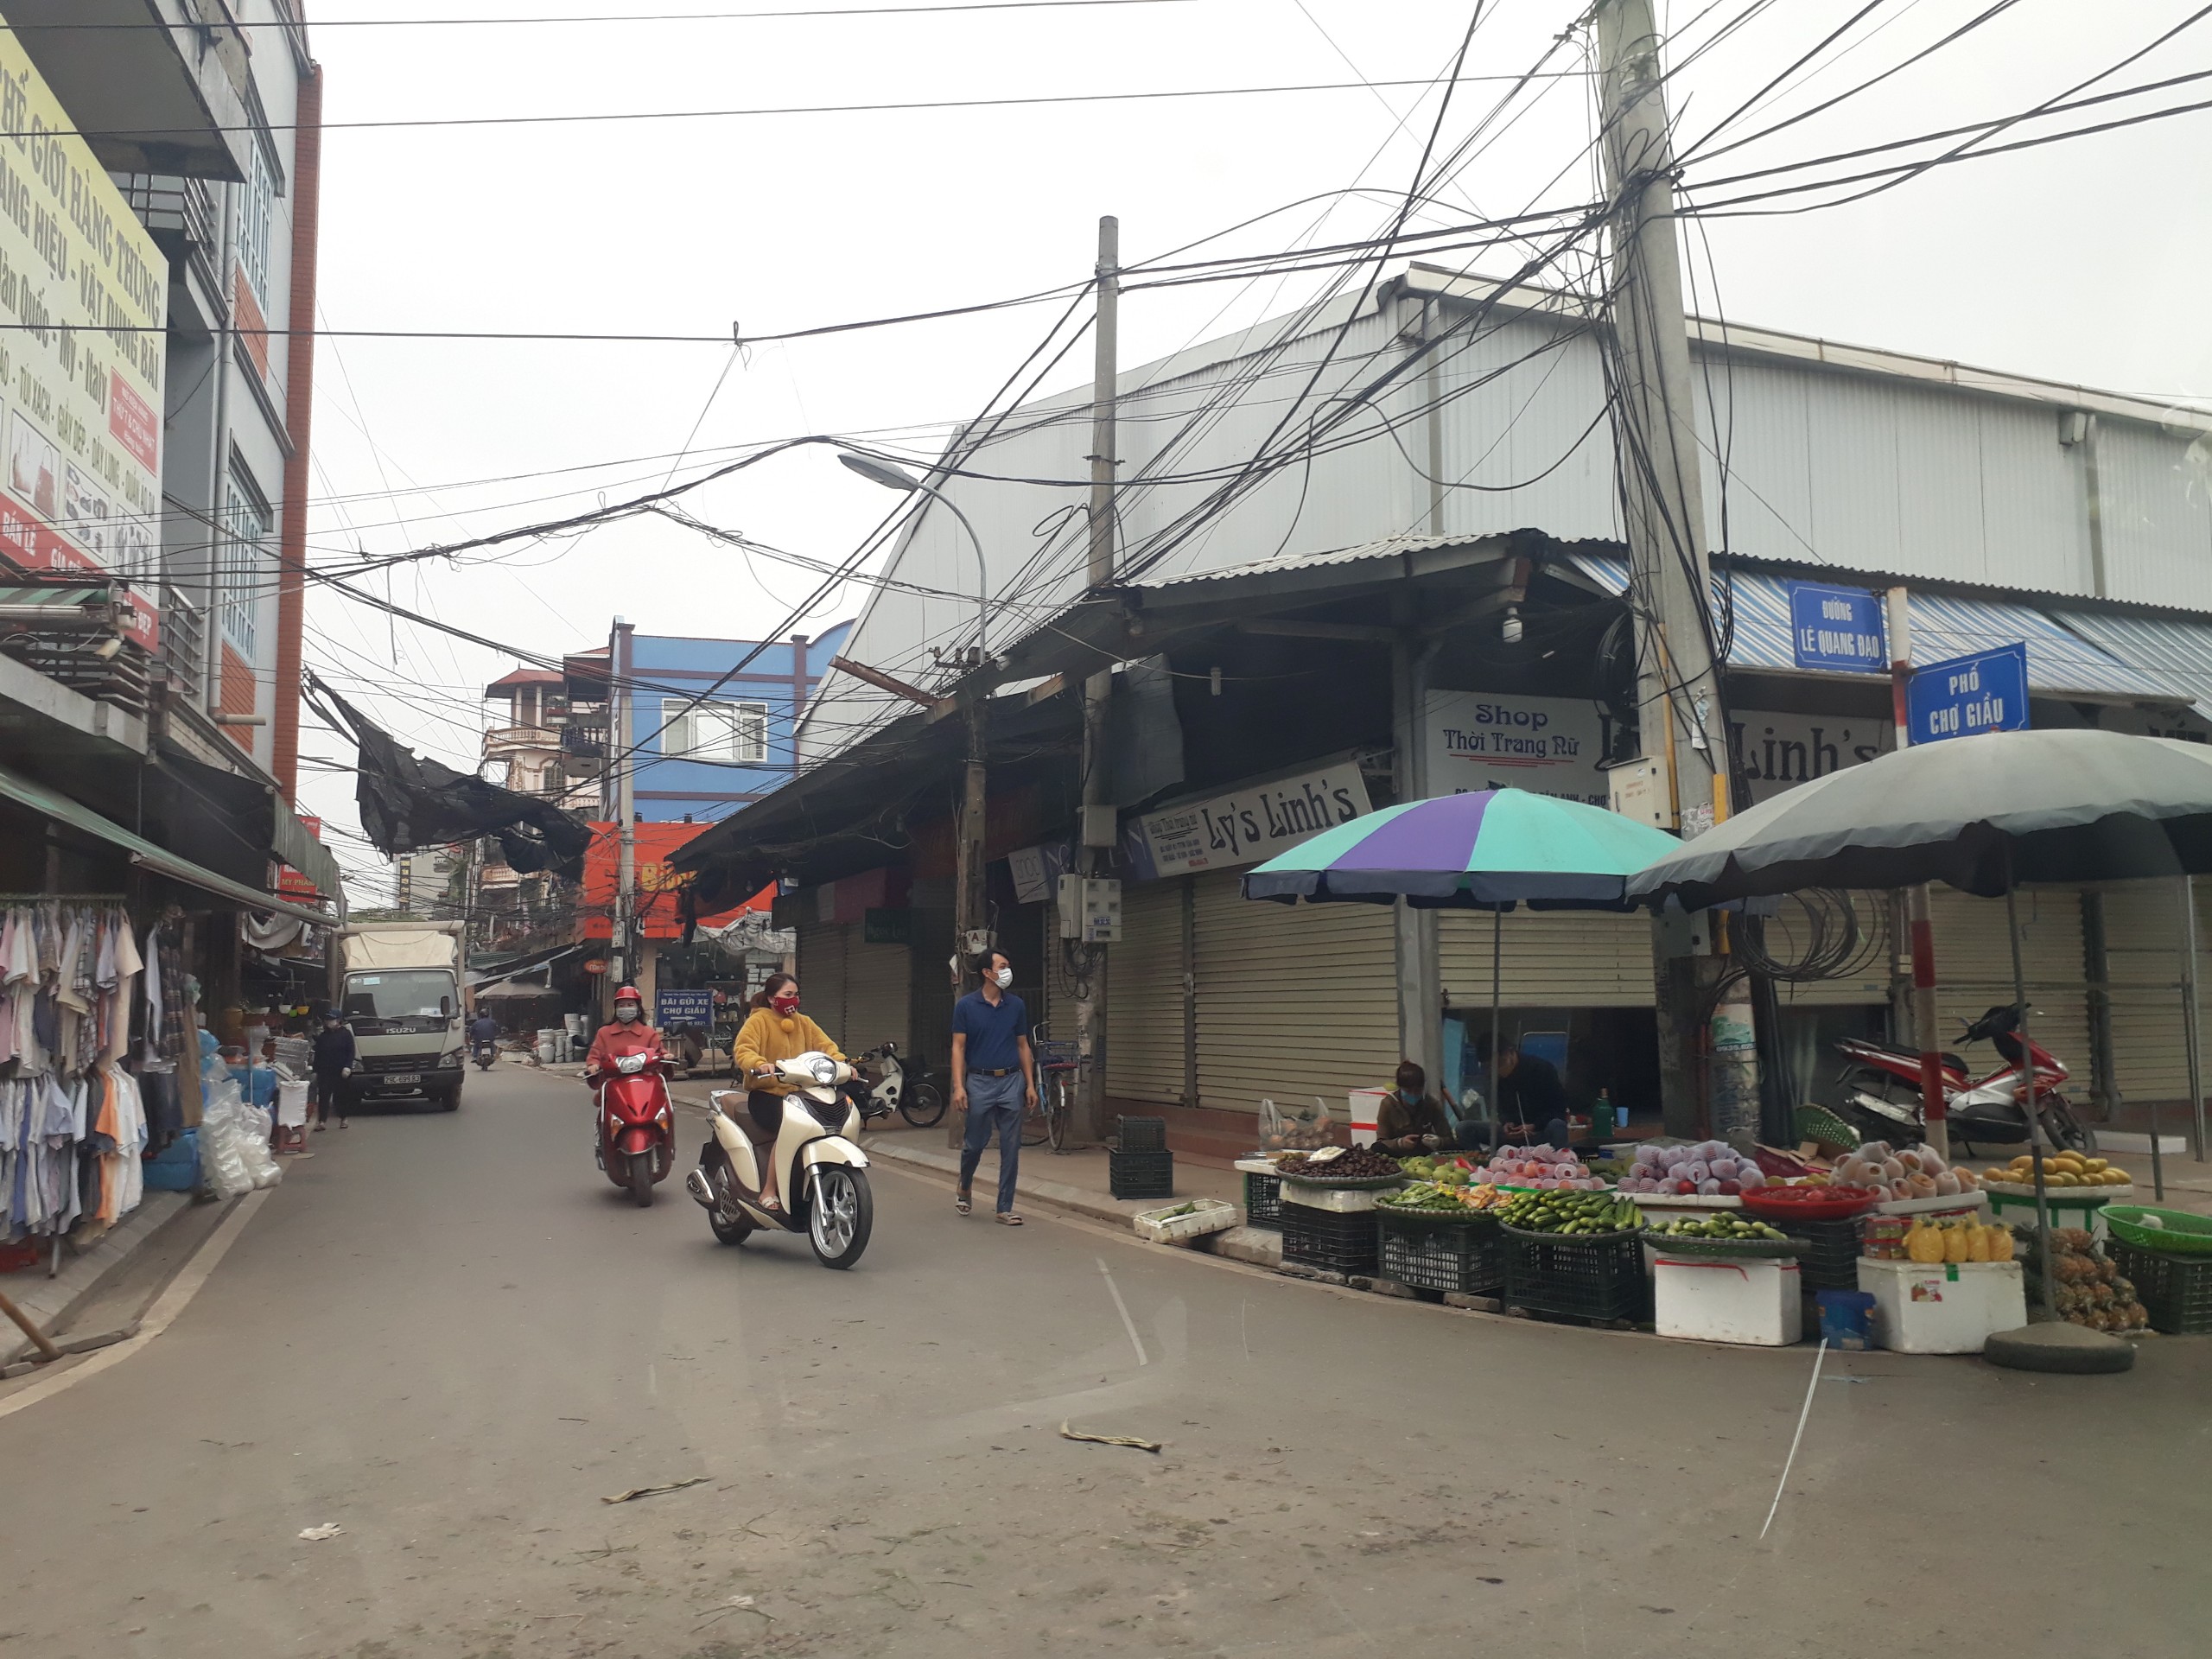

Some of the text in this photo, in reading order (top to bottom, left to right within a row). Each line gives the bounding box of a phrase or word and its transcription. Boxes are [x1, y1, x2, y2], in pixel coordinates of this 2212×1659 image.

[0, 59, 160, 327] HẾ GIỚI HÀNG THÙNG
[34, 200, 67, 282] HIỆU
[80, 258, 104, 327] VẬT
[106, 293, 138, 369] DỤNG
[0, 246, 17, 315] àn
[20, 274, 49, 348] Quốc
[60, 318, 77, 382] Mỹ
[86, 347, 107, 415] Italy
[3, 511, 23, 548] BÁN
[1822, 596, 1853, 621] ĐƯỜNG
[1801, 625, 1880, 662] LÊ QUANG ĐẠO
[1949, 662, 1980, 696] PHỐ
[1475, 704, 1548, 731] Shop
[1929, 702, 1960, 734] CHỢ
[1443, 729, 1580, 758] Thời Trang Nữ
[1201, 779, 1358, 856] Ly's Linh's
[971, 932, 979, 942] A
[663, 1007, 682, 1015] CHỢ
